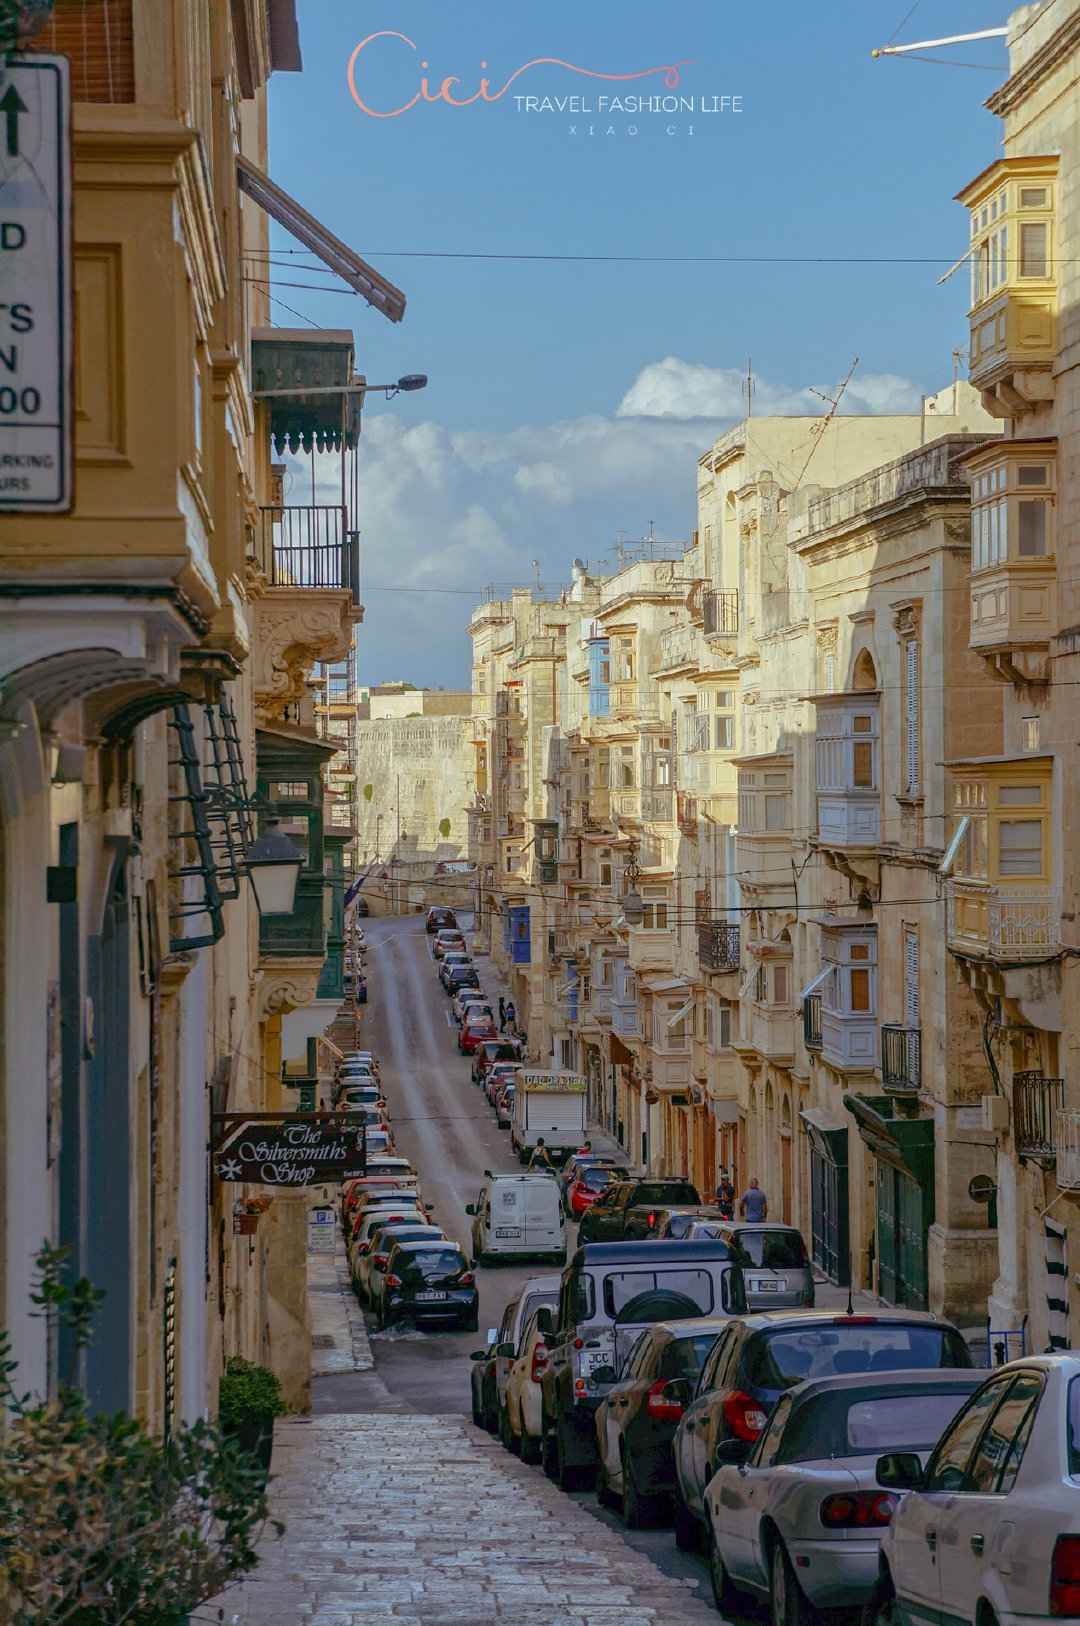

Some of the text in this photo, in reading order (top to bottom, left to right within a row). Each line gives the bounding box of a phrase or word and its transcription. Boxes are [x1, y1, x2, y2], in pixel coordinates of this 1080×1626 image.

[283, 1123, 322, 1144] The
[260, 1162, 316, 1186] Shop
[588, 1353, 609, 1364] JCC
